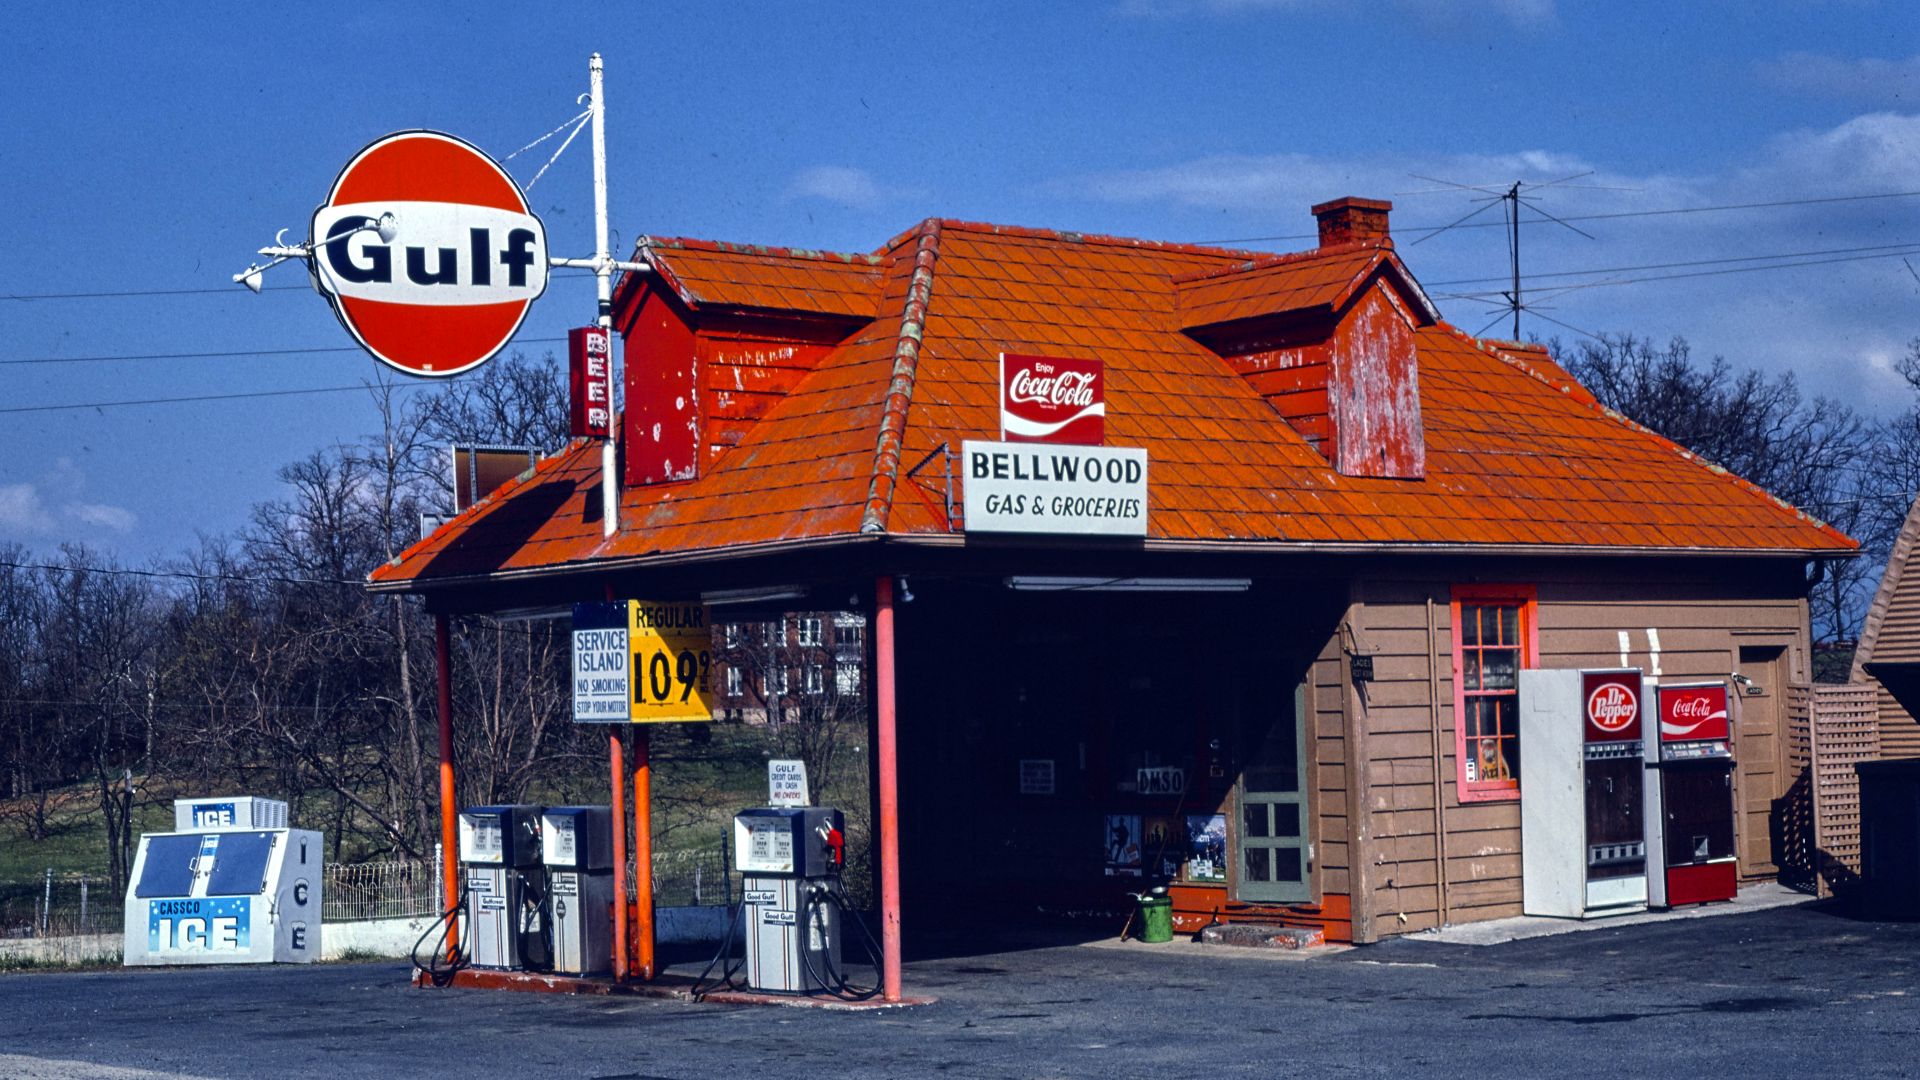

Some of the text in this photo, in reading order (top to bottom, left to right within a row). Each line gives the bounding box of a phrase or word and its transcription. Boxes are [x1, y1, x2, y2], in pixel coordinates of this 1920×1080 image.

[326, 215, 536, 287] Gulf
[1035, 362, 1055, 374] Enjoy
[586, 332, 607, 428] BEER
[1009, 368, 1097, 407] Coca-Cola
[971, 451, 1142, 484] BELLWOOD
[985, 494, 1140, 519] GAS & GROCERIES
[635, 606, 704, 629] REGULAR
[576, 630, 625, 651] SERVICE
[578, 652, 624, 672] ISLAND
[577, 678, 626, 693] NO SMOKING
[1607, 687, 1626, 706] Dr
[576, 701, 627, 714] STOP YOUR MOTOR
[1594, 696, 1633, 725] Pepper
[771, 773, 802, 781] CREDIT CARDS
[775, 764, 796, 773] GULF
[775, 781, 798, 789] OR CASH
[1139, 770, 1183, 793] DMSO
[774, 791, 781, 799] NO
[197, 810, 231, 828] ICE
[290, 835, 310, 950] ICE
[160, 901, 200, 915] CASSCO
[780, 913, 794, 921] Gulf
[158, 917, 238, 950] ICE
